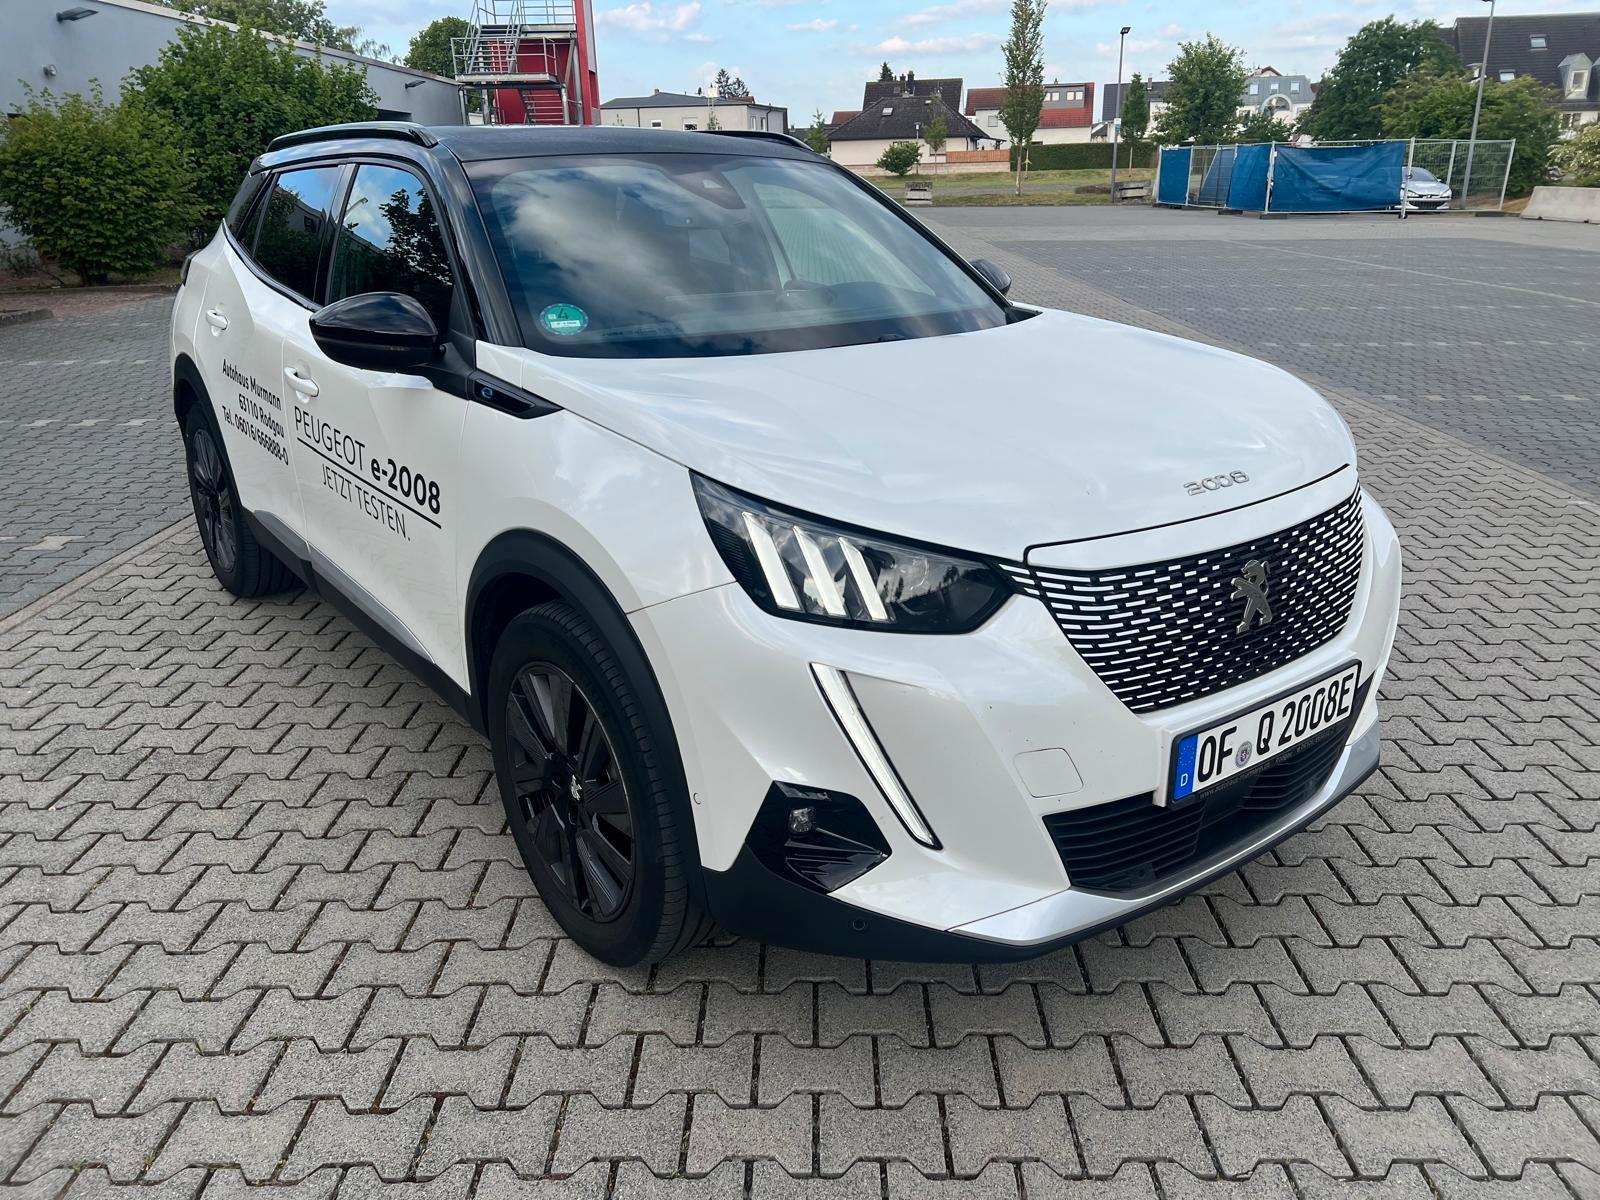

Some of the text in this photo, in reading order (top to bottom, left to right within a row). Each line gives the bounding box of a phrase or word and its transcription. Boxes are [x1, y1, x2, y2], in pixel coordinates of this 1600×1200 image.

[222, 358, 282, 411] Autohaus Murmann
[222, 404, 235, 427] Tel.
[238, 393, 285, 439] 63110 Rodgau
[294, 405, 441, 515] PEUGEOT e-2008
[1183, 469, 1250, 497] 2008
[322, 463, 412, 541] JETZT TESTEN.
[1197, 725, 1238, 783] OF
[1256, 710, 1275, 756] Q
[1278, 673, 1355, 748] 2008E
[1180, 773, 1188, 787] D
